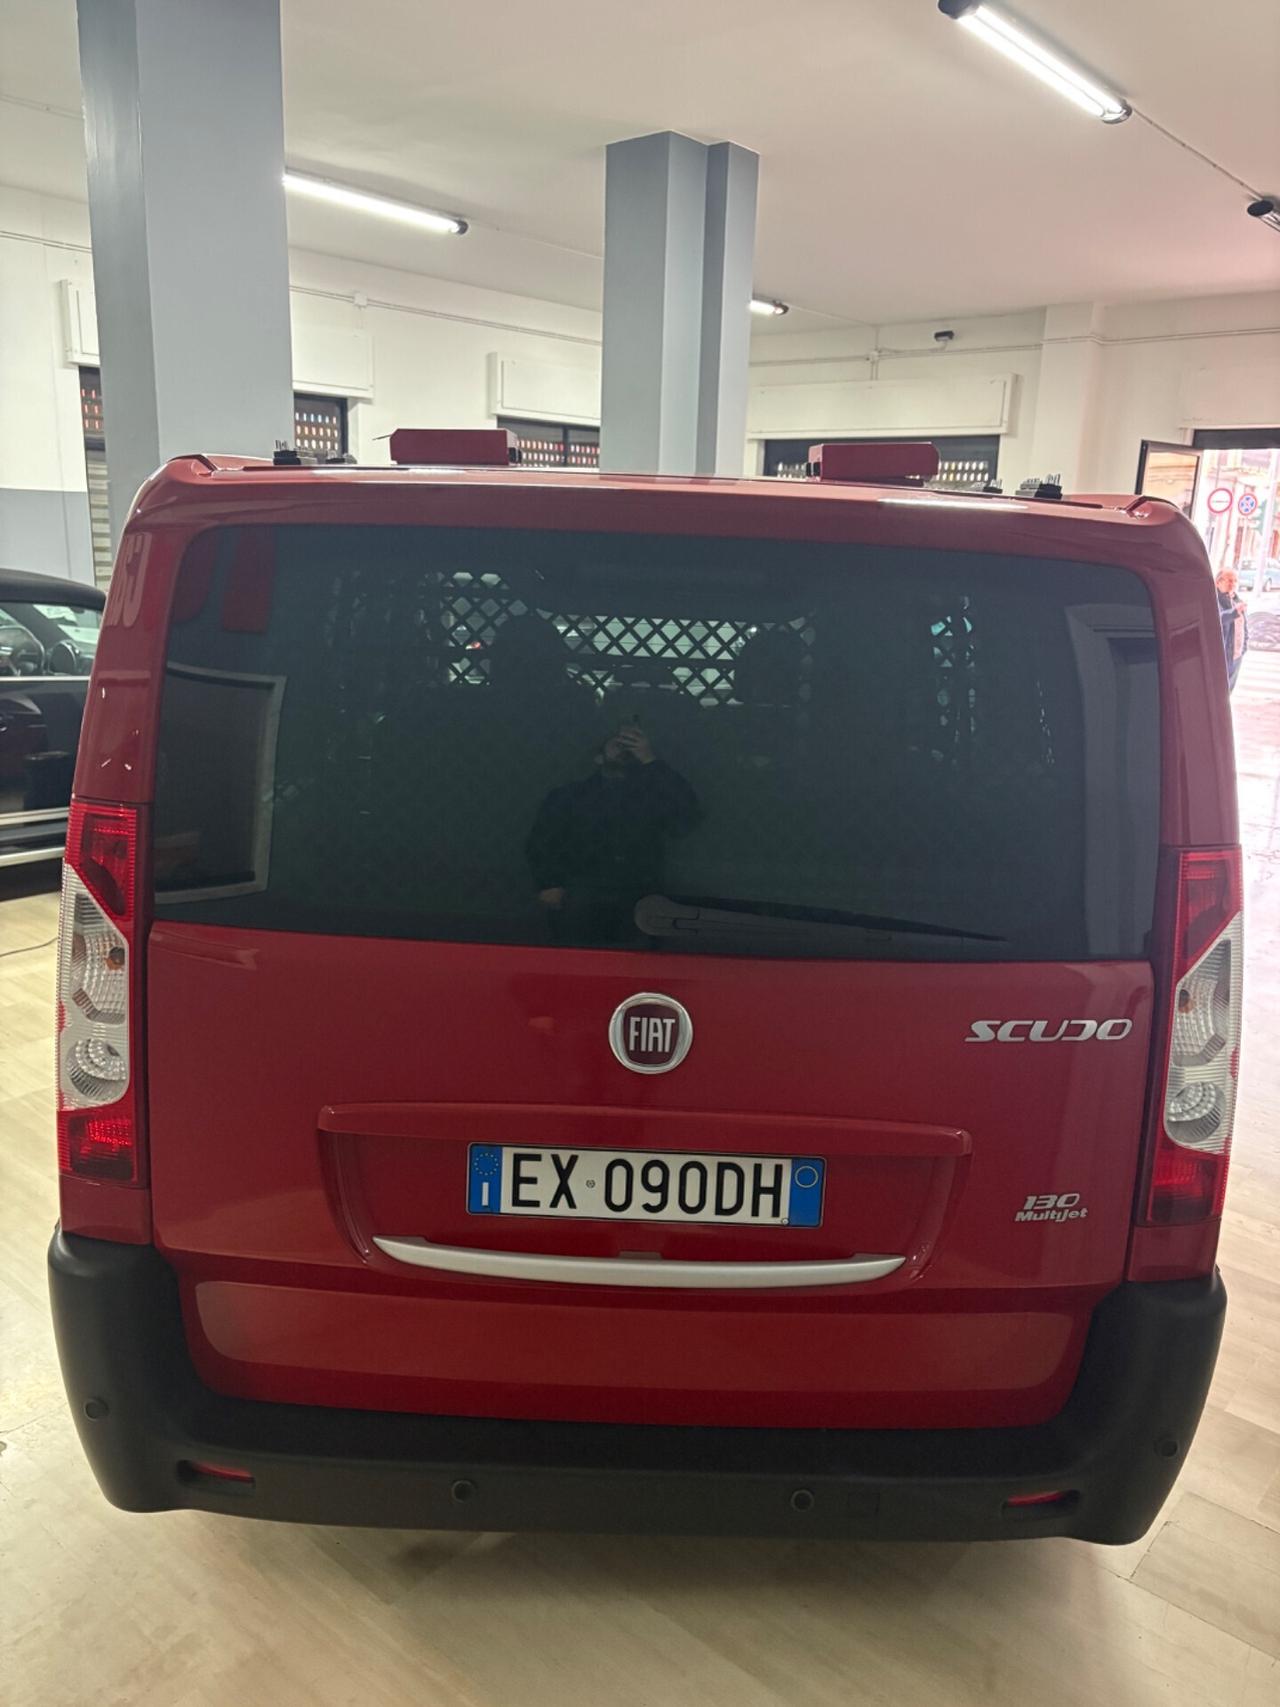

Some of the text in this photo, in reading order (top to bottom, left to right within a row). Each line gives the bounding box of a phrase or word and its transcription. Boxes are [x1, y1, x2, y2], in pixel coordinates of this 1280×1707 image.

[629, 1016, 676, 1053] FIAT
[964, 1018, 1133, 1042] SCUDO
[481, 1182, 489, 1207] I
[511, 1153, 783, 1218] EX 090DH
[1026, 1193, 1081, 1210] 130
